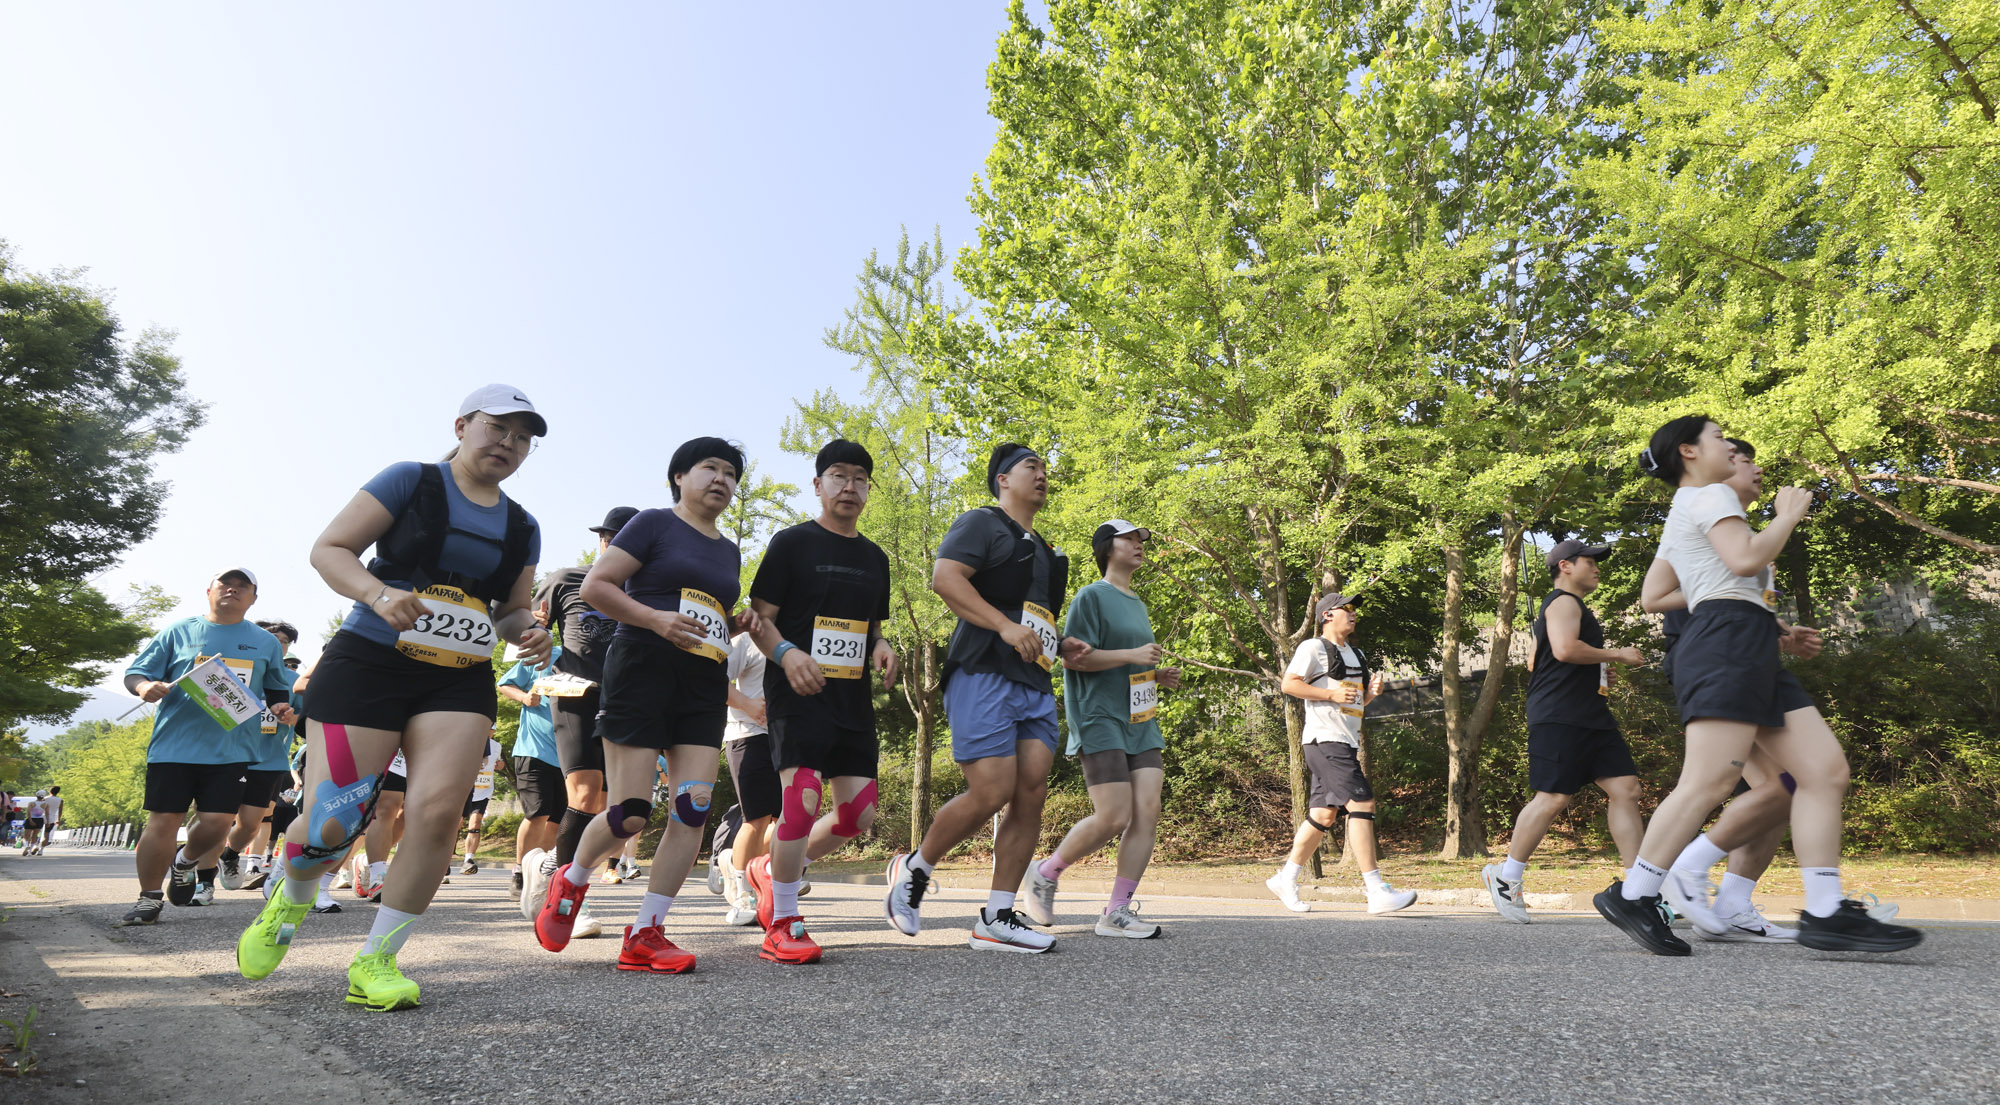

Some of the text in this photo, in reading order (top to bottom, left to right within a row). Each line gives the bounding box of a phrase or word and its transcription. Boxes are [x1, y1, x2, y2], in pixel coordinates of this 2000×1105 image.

[413, 613, 492, 646] 3232
[817, 637, 864, 659] 3231
[204, 673, 247, 713] 동물복지
[1133, 687, 1156, 706] 3439
[260, 712, 275, 723] 56
[356, 785, 370, 798] BB
[323, 793, 356, 813] TAPE
